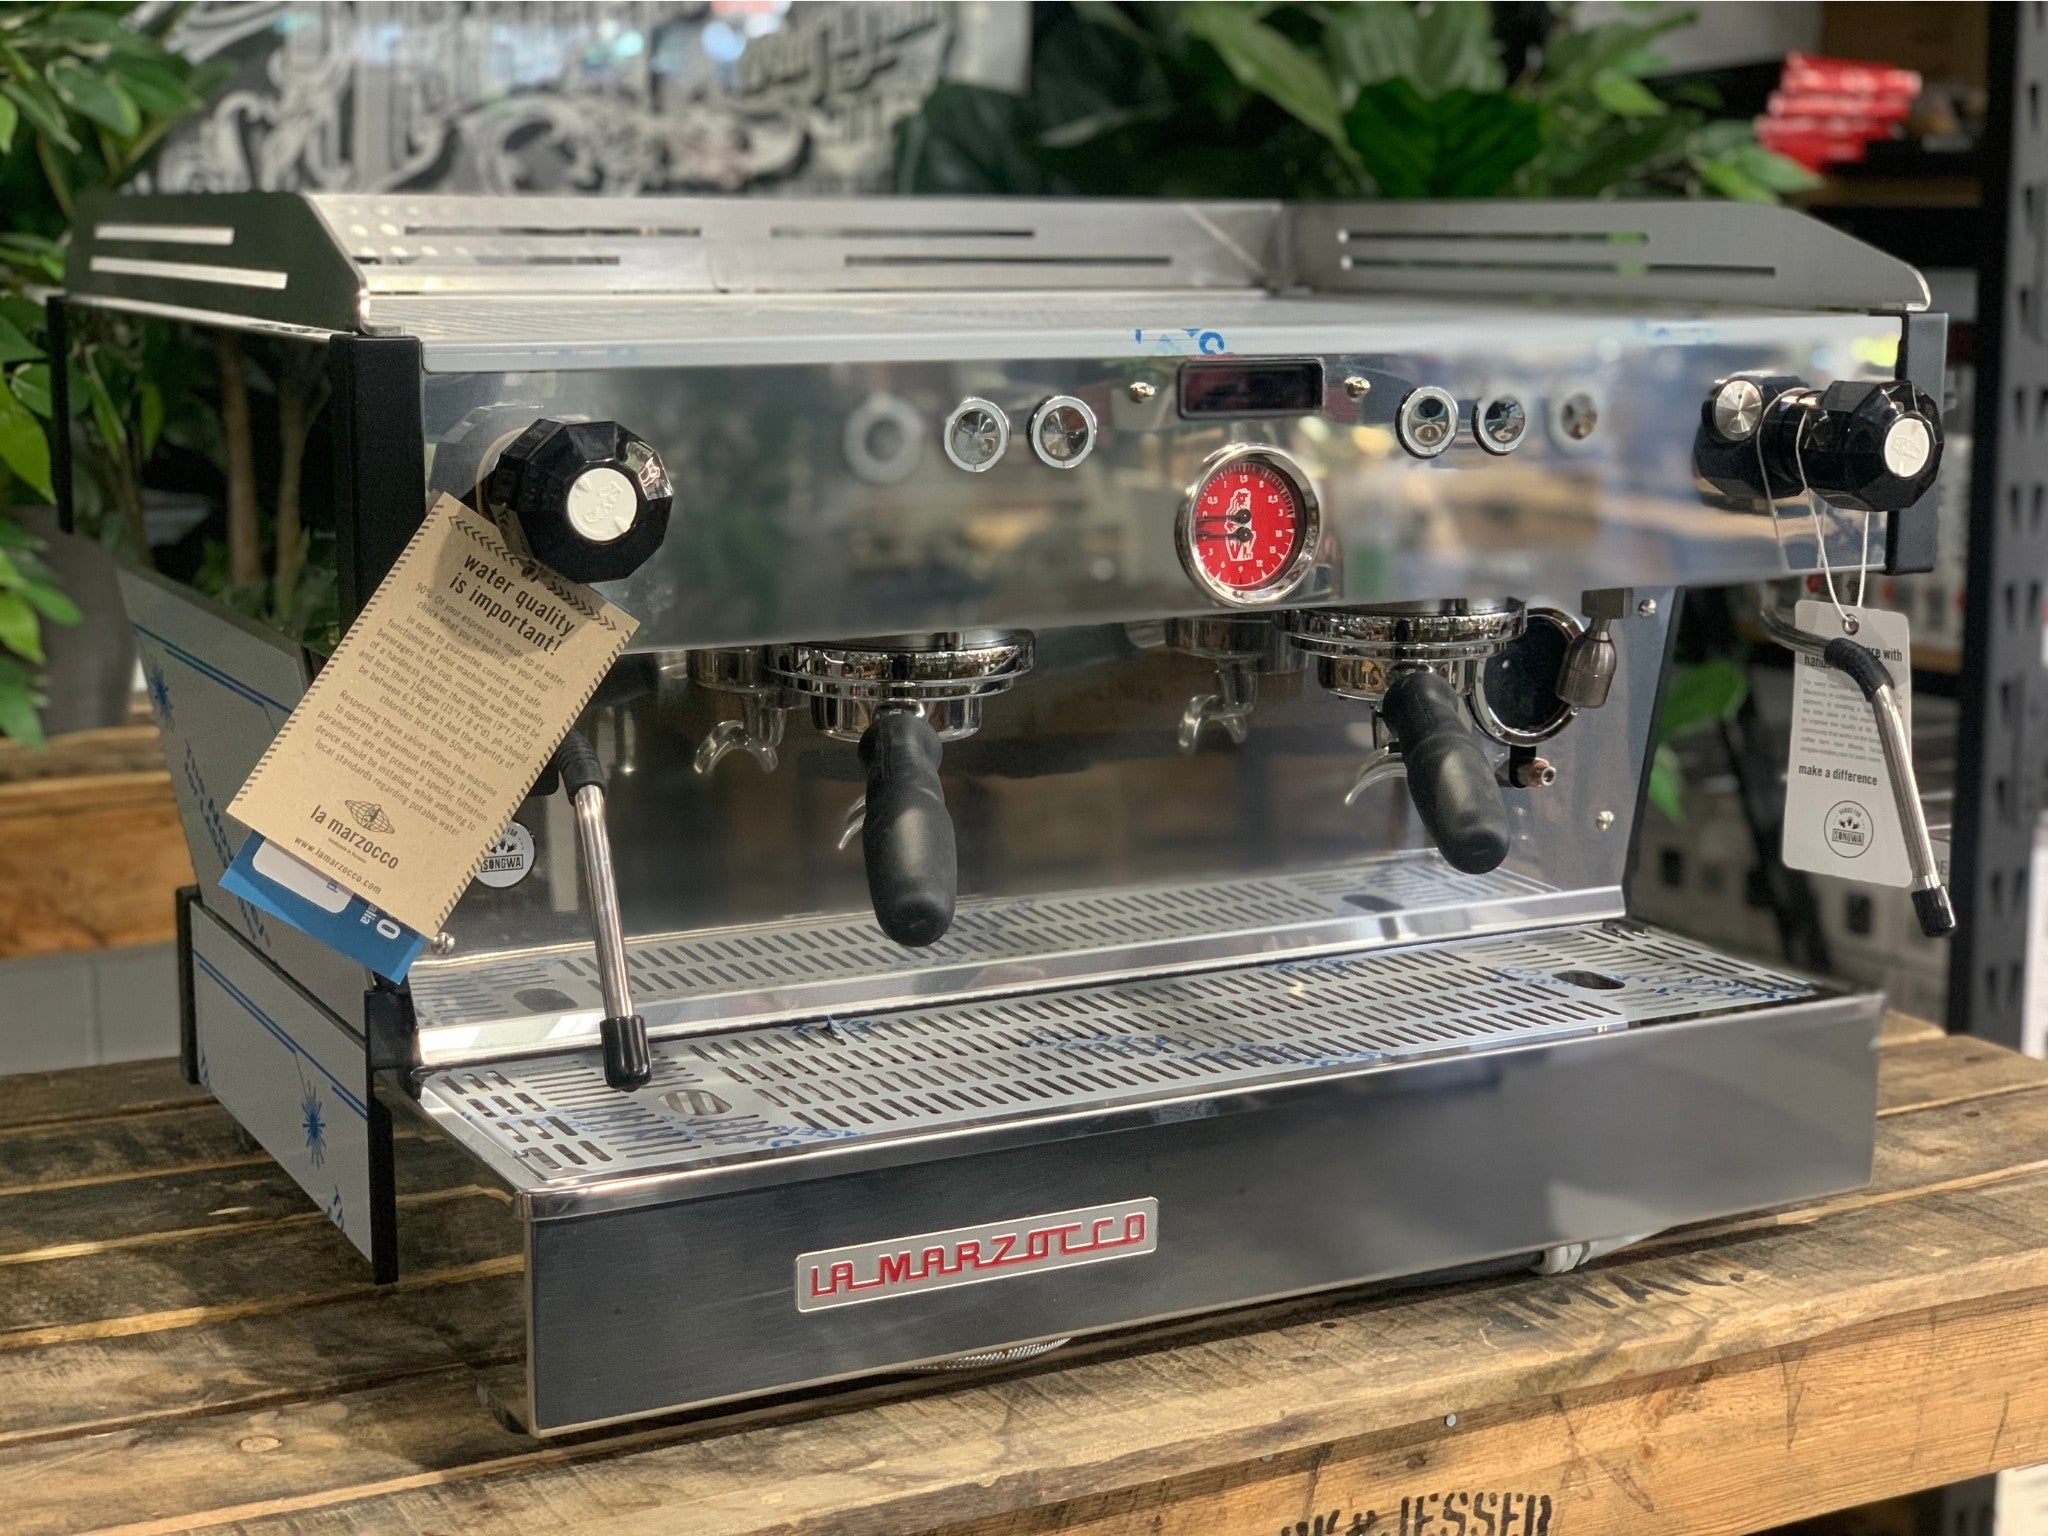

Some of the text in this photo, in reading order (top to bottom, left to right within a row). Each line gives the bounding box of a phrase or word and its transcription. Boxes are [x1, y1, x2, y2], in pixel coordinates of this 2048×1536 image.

[414, 581, 435, 599] 90%
[443, 603, 462, 618] your
[460, 614, 495, 640] espresso
[494, 636, 503, 646] is
[502, 642, 524, 660] made
[523, 656, 535, 667] up
[534, 663, 546, 673] of
[448, 571, 565, 657] is important!
[463, 554, 576, 638] water quality
[369, 640, 381, 650] of
[378, 646, 387, 656] a
[385, 649, 421, 678] hardness
[419, 673, 450, 696] greater
[447, 691, 467, 708] than
[466, 702, 494, 726] 90ppm
[375, 627, 416, 658] beverages
[414, 652, 425, 664] in
[423, 658, 438, 673] the
[454, 680, 489, 708] incoming
[488, 701, 511, 720] water
[509, 716, 531, 734] must
[529, 727, 541, 741] be
[386, 617, 547, 729] functioning of your machine and high quality
[405, 613, 542, 709] In order to guarantee correct and safe
[416, 601, 440, 620] check
[438, 615, 460, 633] what
[456, 628, 482, 648] you're
[479, 643, 509, 668] putting
[508, 662, 518, 672] in
[515, 667, 535, 682] your
[1883, 648, 1903, 661] with
[338, 689, 498, 798] Respecting these values allows the machine
[357, 649, 376, 664] and
[373, 658, 391, 674] less
[390, 669, 410, 686] than
[409, 680, 440, 706] 150ppm
[490, 736, 504, 748] ph
[502, 744, 531, 765] should
[357, 663, 516, 771] be between 6.5 And 8.5 And the quantity of
[378, 695, 414, 722] chlorides
[413, 716, 431, 733] less
[430, 727, 449, 745] than
[314, 724, 342, 745] device
[340, 740, 369, 761] should
[366, 756, 379, 768] be
[413, 787, 435, 805] while
[433, 801, 468, 827] adhering
[466, 820, 477, 832] to
[314, 738, 336, 757] local
[334, 753, 374, 782] standards
[372, 777, 410, 807] regarding
[407, 801, 439, 824] potable
[316, 709, 362, 742] parameters
[361, 738, 376, 751] are
[374, 746, 391, 760] not
[388, 755, 419, 779] present
[418, 774, 426, 783] a
[425, 779, 456, 802] specific
[334, 703, 345, 714] to
[343, 710, 374, 734] operate
[372, 729, 385, 740] at
[382, 735, 420, 764] maximum
[464, 787, 488, 807] these
[1798, 764, 1878, 786] make a difference
[294, 835, 382, 895] www.lamarzocco.com
[309, 803, 328, 825] la
[326, 817, 400, 870] marzocco
[482, 856, 521, 870] SONGWA
[810, 1211, 1147, 1298] LA MARZOCCO
